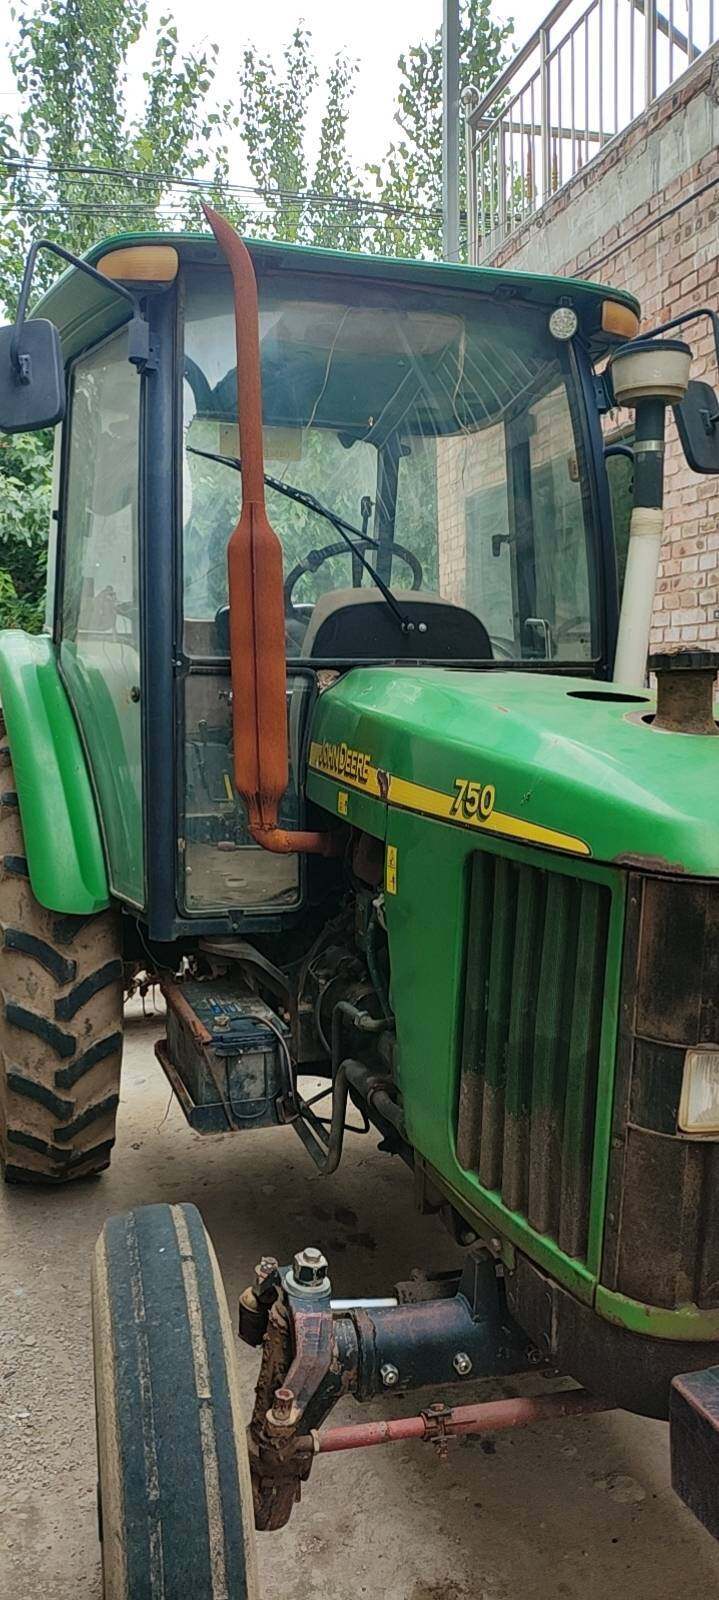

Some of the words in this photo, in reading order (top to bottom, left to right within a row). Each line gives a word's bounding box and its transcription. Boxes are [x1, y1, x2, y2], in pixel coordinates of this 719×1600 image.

[317, 741, 340, 773] JOHN
[338, 742, 371, 784] DEERE
[449, 778, 496, 822] 750
